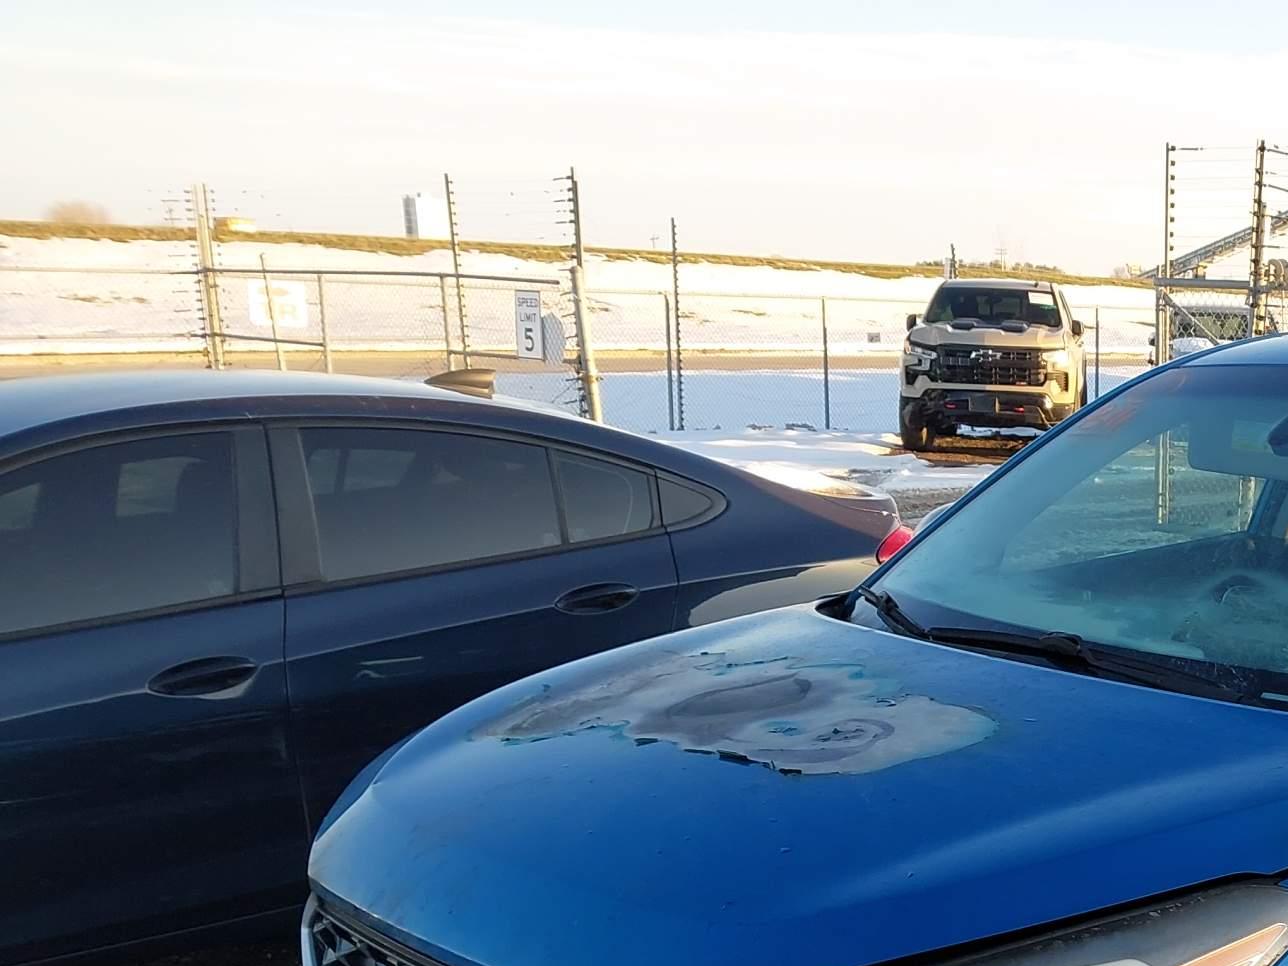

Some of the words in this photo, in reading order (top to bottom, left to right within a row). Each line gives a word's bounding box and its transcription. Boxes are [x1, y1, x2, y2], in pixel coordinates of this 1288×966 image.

[517, 297, 538, 308] SPEED
[519, 312, 537, 323] LIMIT
[524, 327, 535, 352] 5
